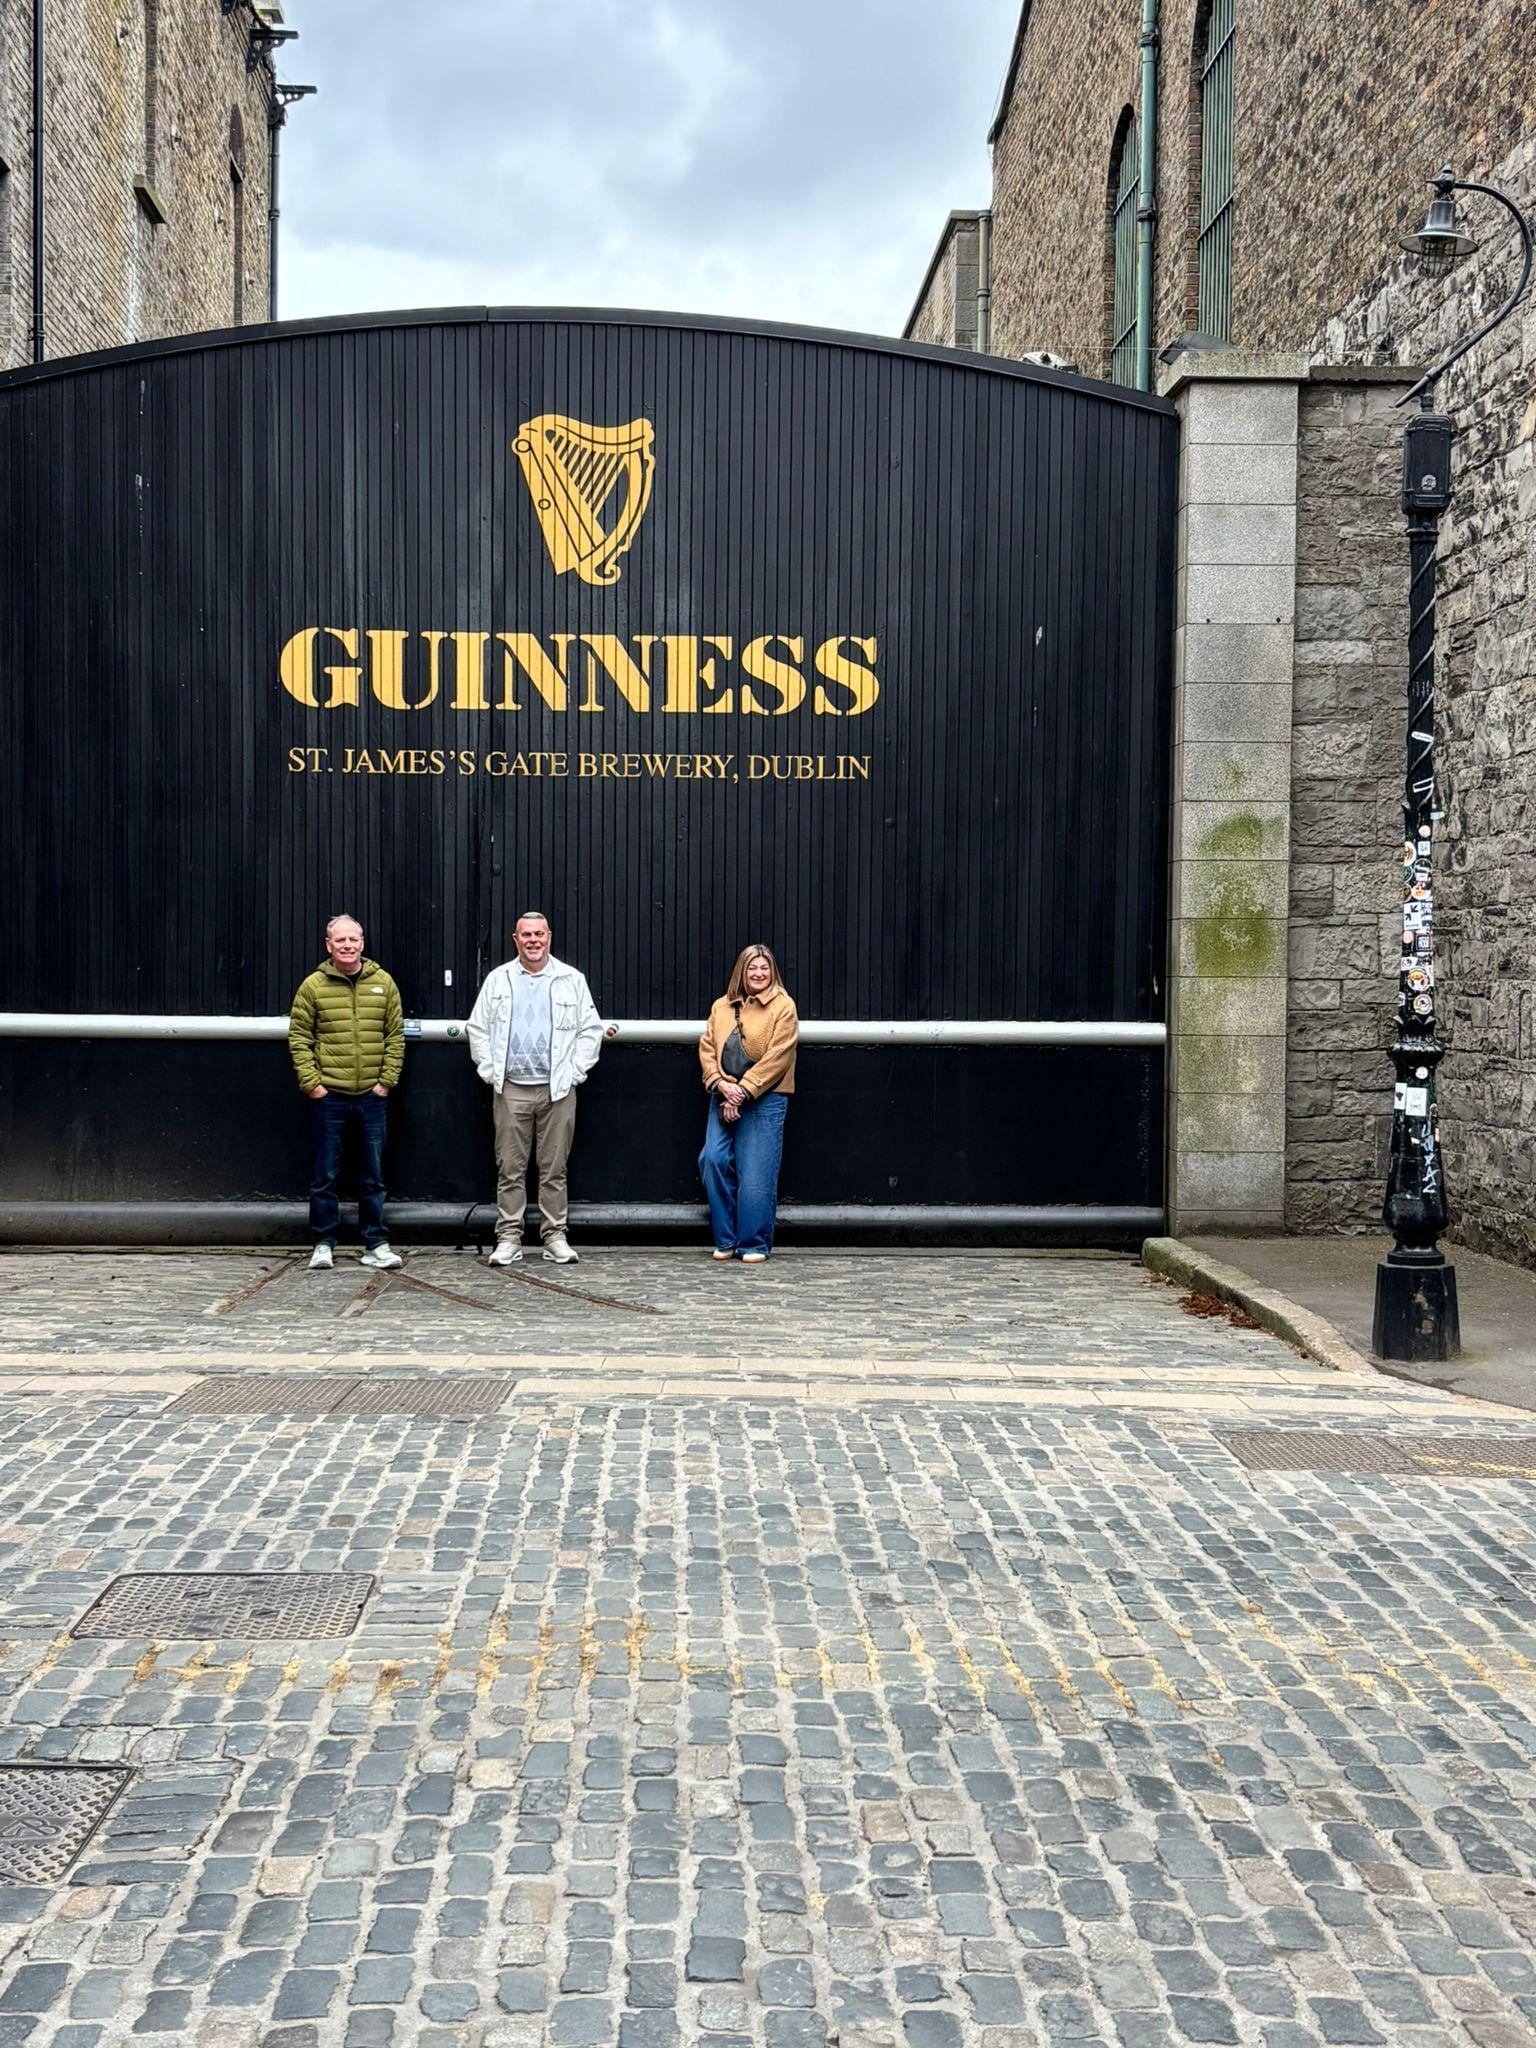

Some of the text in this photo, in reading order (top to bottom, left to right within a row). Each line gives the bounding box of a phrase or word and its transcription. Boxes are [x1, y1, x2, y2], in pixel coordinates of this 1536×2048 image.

[279, 626, 881, 717] GUINNESS
[287, 747, 872, 784] ST. JAMES’S GATE BREWERY, DUBLIN
